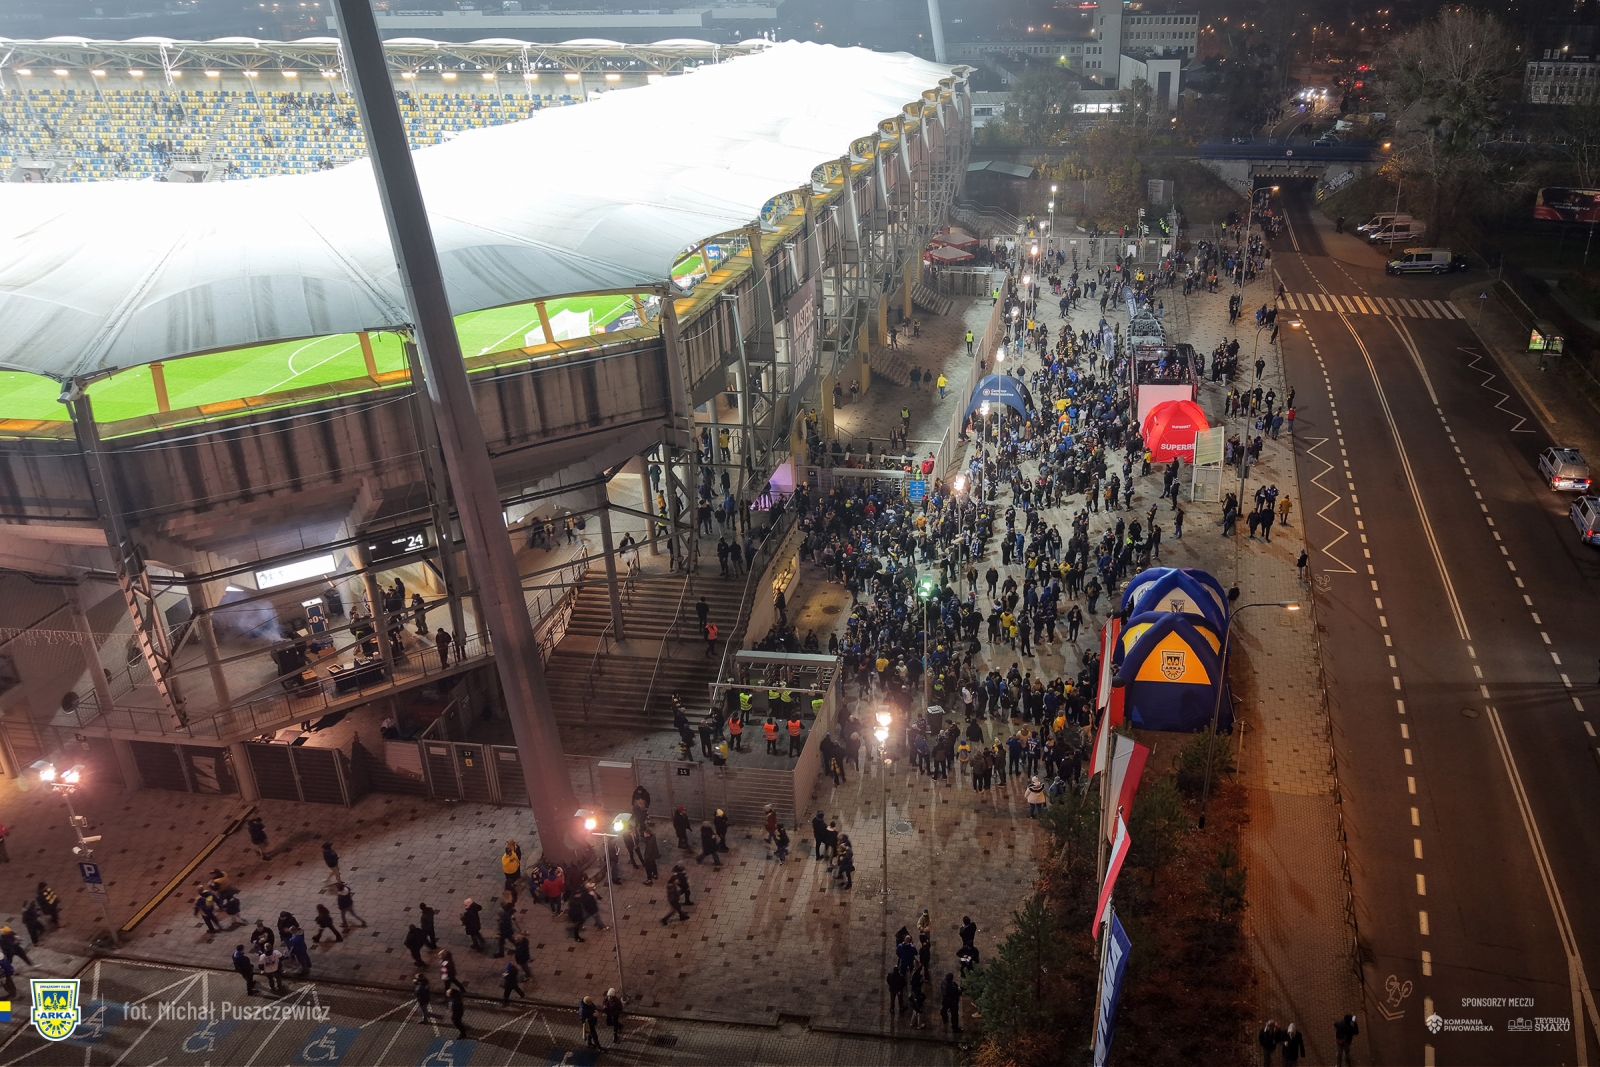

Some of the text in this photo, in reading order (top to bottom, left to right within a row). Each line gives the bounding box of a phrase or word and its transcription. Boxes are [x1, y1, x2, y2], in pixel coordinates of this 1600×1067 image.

[1160, 443, 1196, 451] SUPERBE
[407, 534, 423, 547] 24
[83, 864, 95, 877] P
